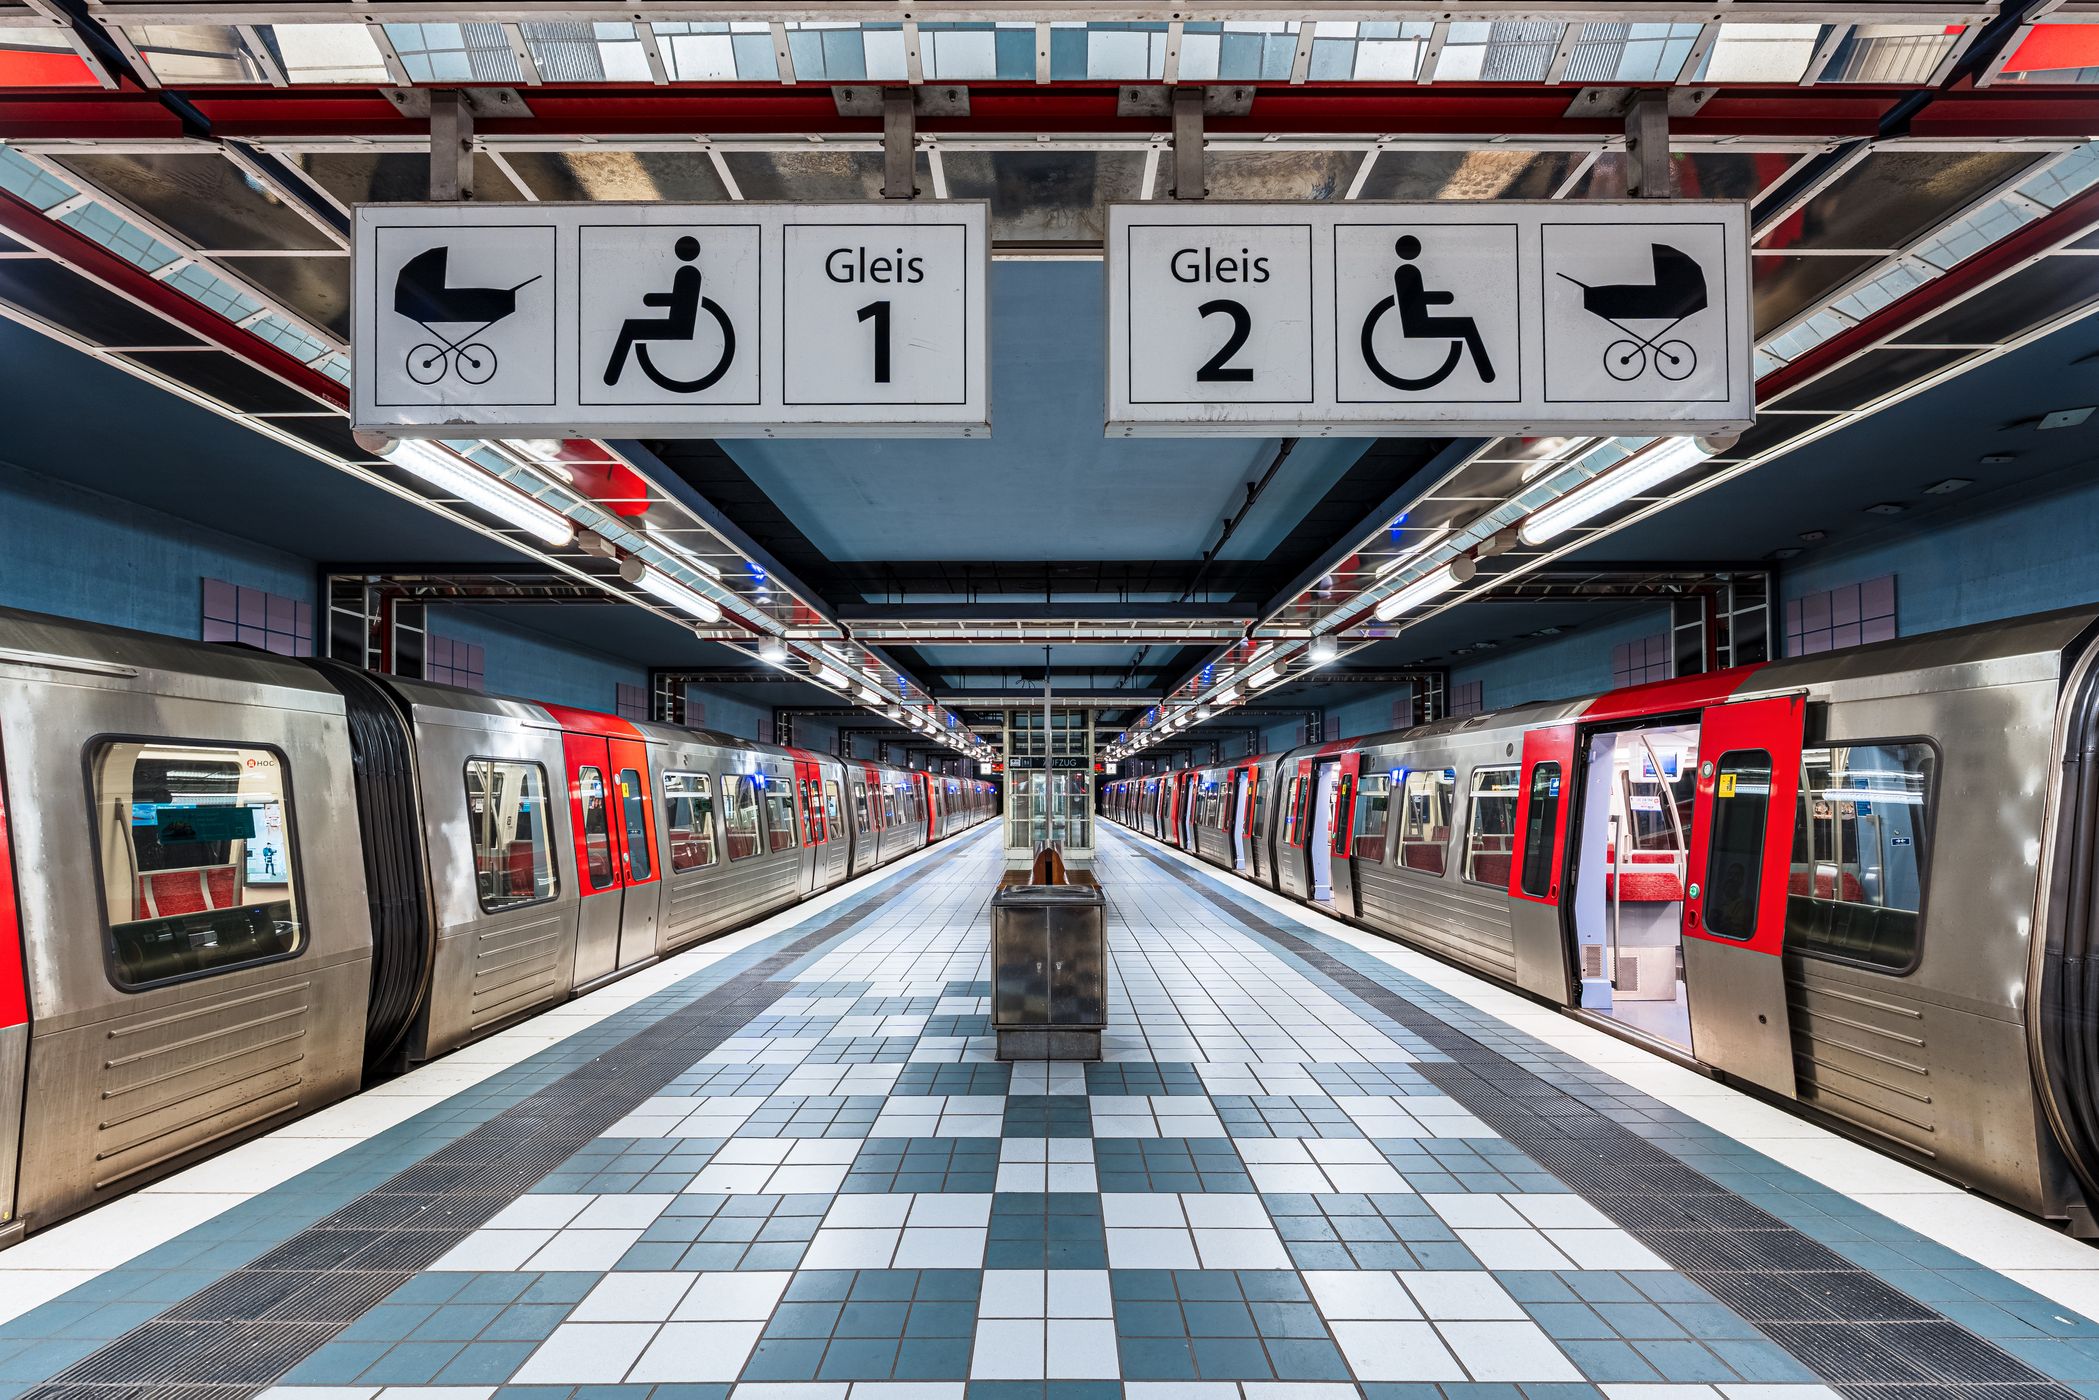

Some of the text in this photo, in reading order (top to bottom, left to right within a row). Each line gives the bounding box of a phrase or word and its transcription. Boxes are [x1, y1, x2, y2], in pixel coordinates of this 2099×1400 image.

[825, 246, 924, 284] Gleis
[1170, 246, 1270, 284] Gleis
[856, 300, 891, 384] 1
[1196, 299, 1254, 383] 2
